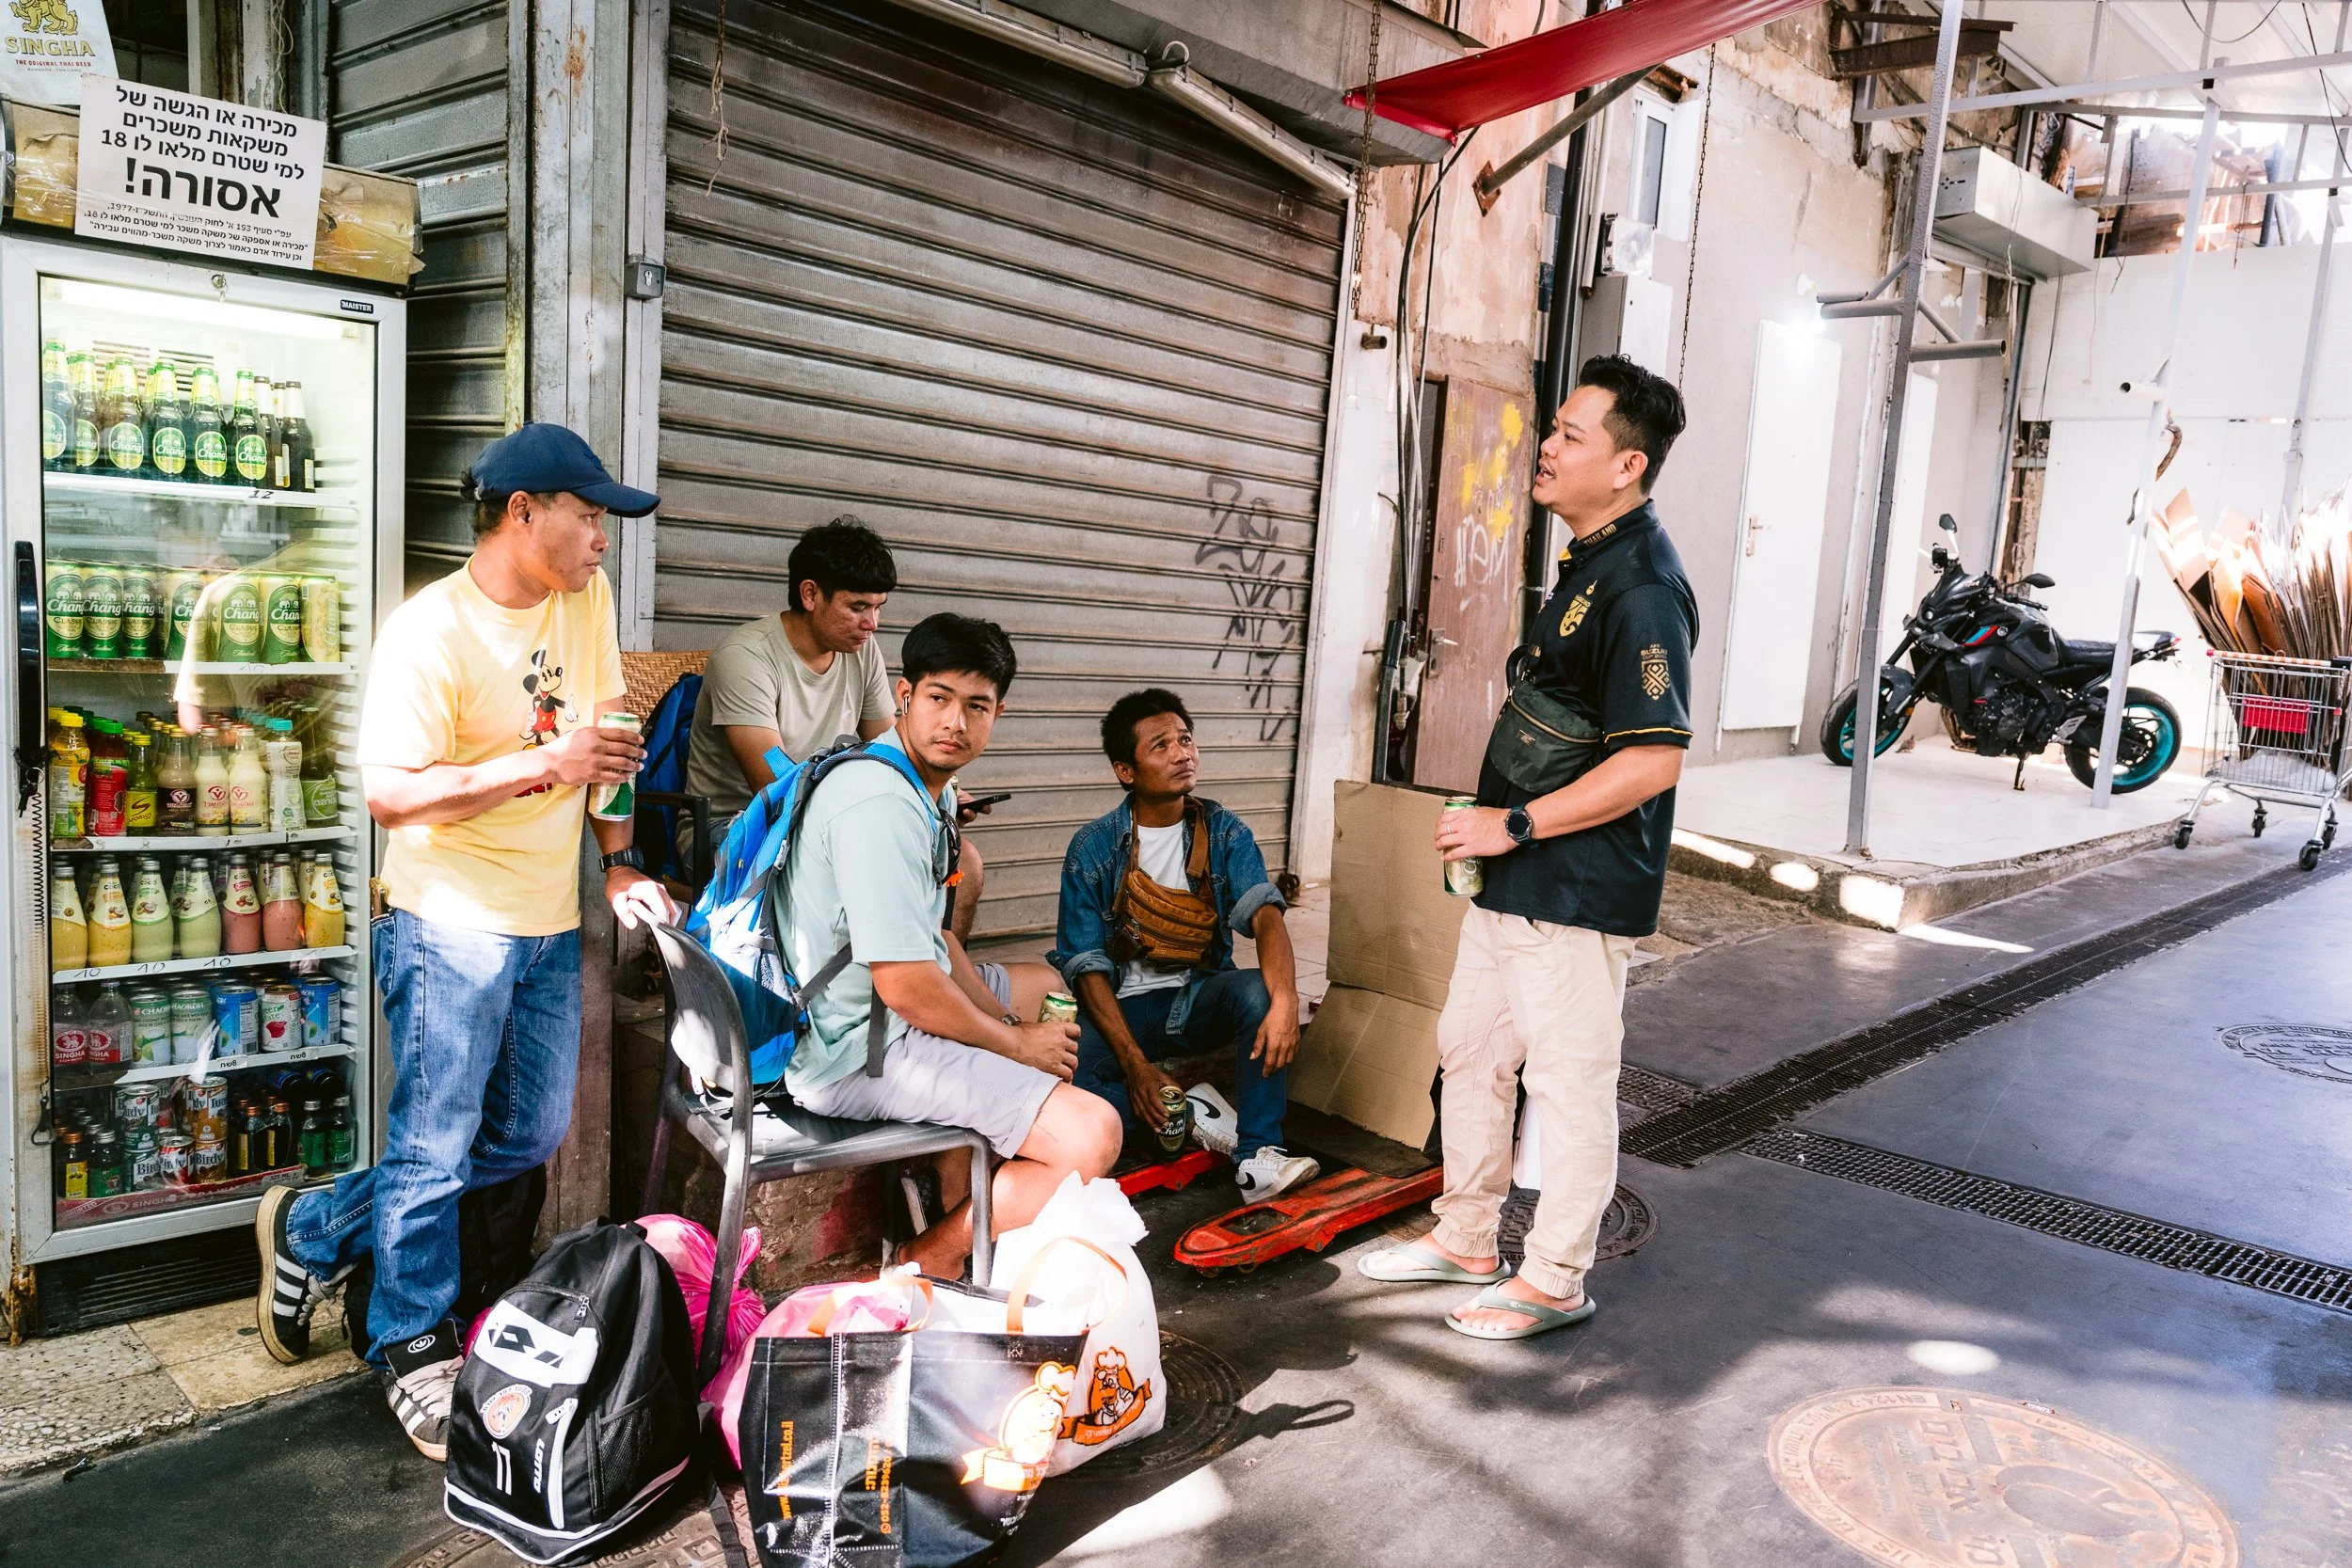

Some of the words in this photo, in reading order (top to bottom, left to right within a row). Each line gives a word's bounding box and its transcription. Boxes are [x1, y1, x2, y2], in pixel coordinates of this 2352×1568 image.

[5, 36, 96, 57] SINGHA
[116, 85, 147, 107] של
[153, 95, 209, 120] הגשה
[216, 108, 236, 126] או
[123, 111, 201, 140] משכרים
[242, 114, 296, 138] מכירה
[101, 128, 128, 148] 18
[134, 134, 151, 152] לו
[207, 129, 288, 157] משקאות
[158, 140, 206, 163] מלאו
[213, 150, 268, 174] שטרם
[274, 163, 305, 181] למי
[124, 156, 281, 219] אסורה!
[100, 211, 108, 219] לו
[110, 214, 132, 223] מלאו
[134, 217, 159, 228] שטרם
[160, 222, 175, 230] למי
[204, 217, 224, 229] לחוק
[236, 223, 251, 232] 193
[176, 224, 199, 234] משכר
[201, 229, 227, 239] משקה
[253, 226, 273, 235] סעיף
[176, 235, 202, 245] משקה
[228, 232, 241, 241] של
[242, 236, 271, 245] אספקה
[204, 240, 226, 249] לצרוך
[228, 244, 251, 253] כאמור
[253, 247, 269, 256] אדם
[272, 250, 292, 259] עידוד
[341, 300, 373, 311] MAISTER
[111, 440, 143, 452] Chang
[155, 444, 185, 458] Chang
[198, 448, 227, 462] Chang
[238, 451, 267, 464] Chang
[1582, 523, 1617, 547] THAILAND
[82, 599, 122, 616] Chang
[123, 601, 155, 616] hang
[223, 605, 259, 623] Chang
[270, 608, 300, 621] Chan
[1640, 648, 1668, 657] SUZUKI
[137, 962, 166, 974] 10
[203, 957, 231, 968] 10
[73, 968, 102, 978] 10
[171, 1002, 204, 1010] HAOKOH
[55, 1050, 86, 1059] SINGHA
[533, 1437, 546, 1494] LOTTO
